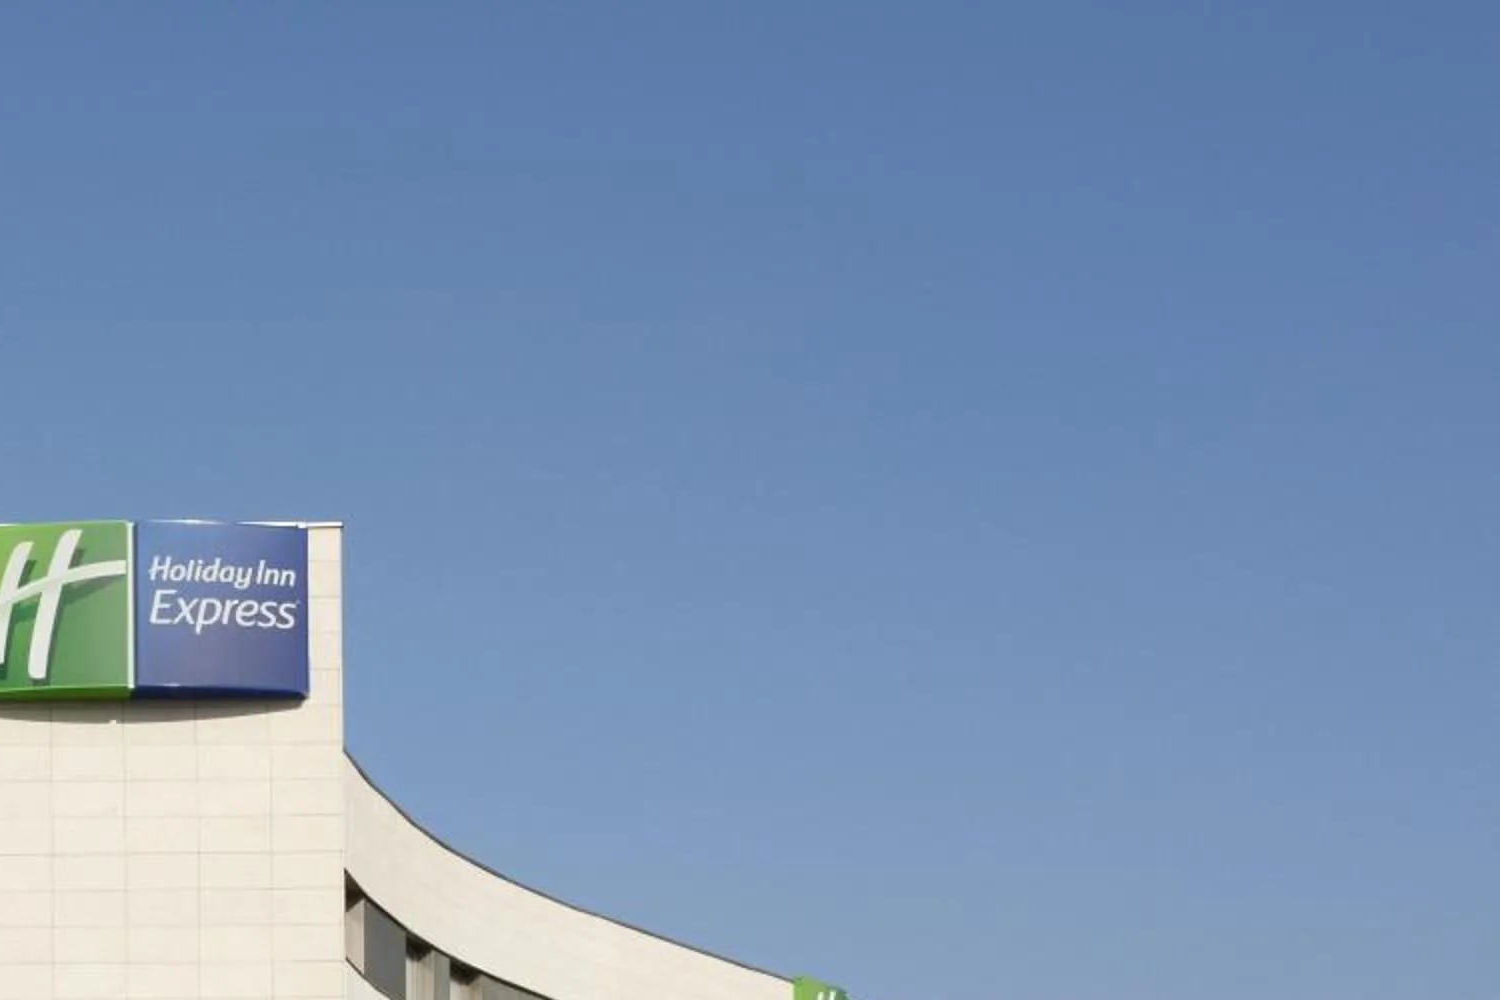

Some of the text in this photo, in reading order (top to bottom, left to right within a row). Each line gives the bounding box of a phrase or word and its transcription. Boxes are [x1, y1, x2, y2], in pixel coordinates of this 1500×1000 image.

[148, 556, 296, 589] Holiday Inn
[149, 589, 297, 635] Express
